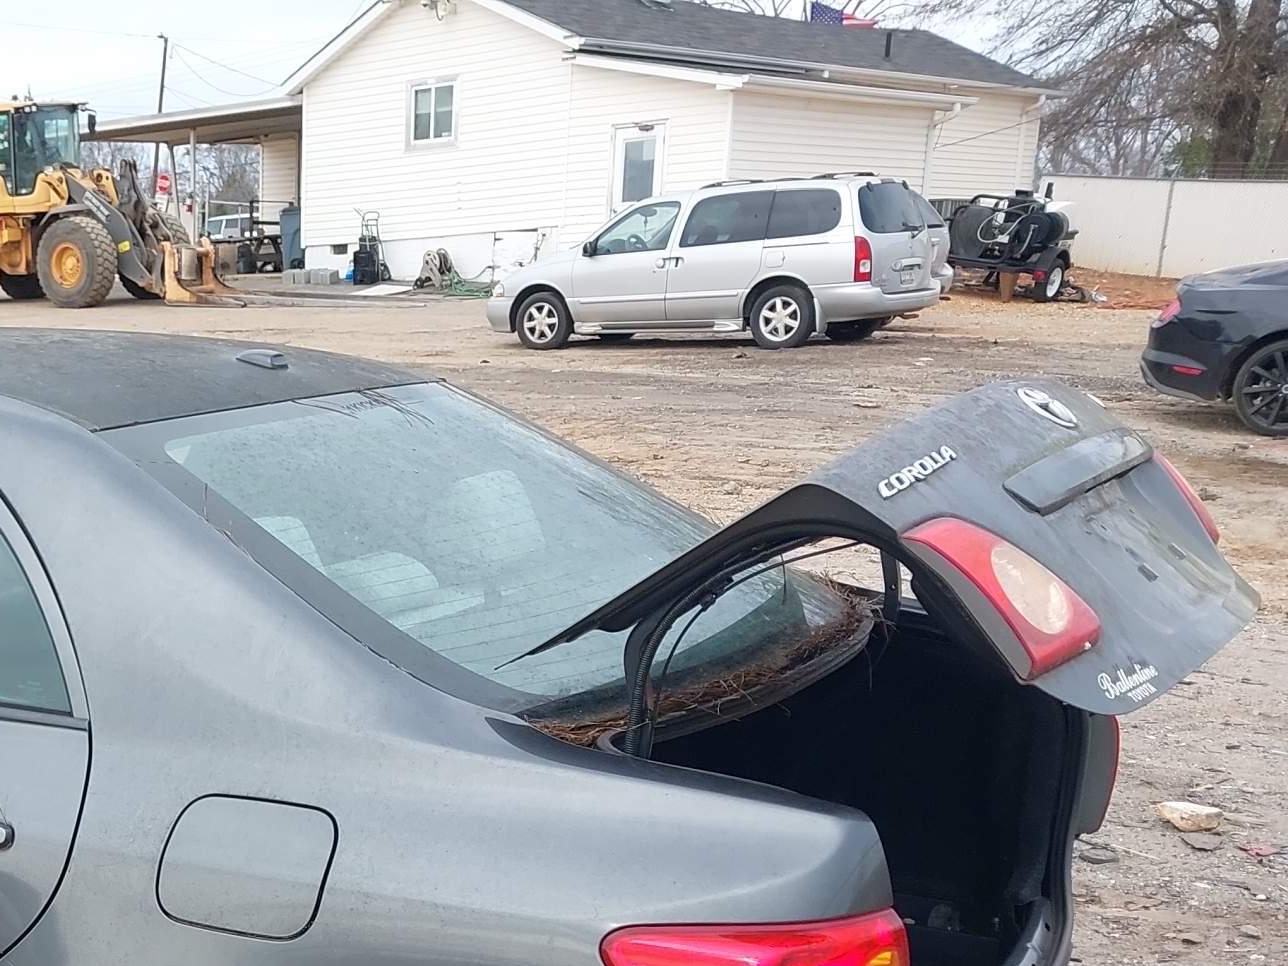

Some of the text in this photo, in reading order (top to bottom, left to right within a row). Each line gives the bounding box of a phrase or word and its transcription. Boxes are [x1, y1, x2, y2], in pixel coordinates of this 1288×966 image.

[878, 445, 957, 498] COROLLA
[1097, 663, 1158, 699] Ballentine
[1127, 682, 1157, 703] TOYOTA
